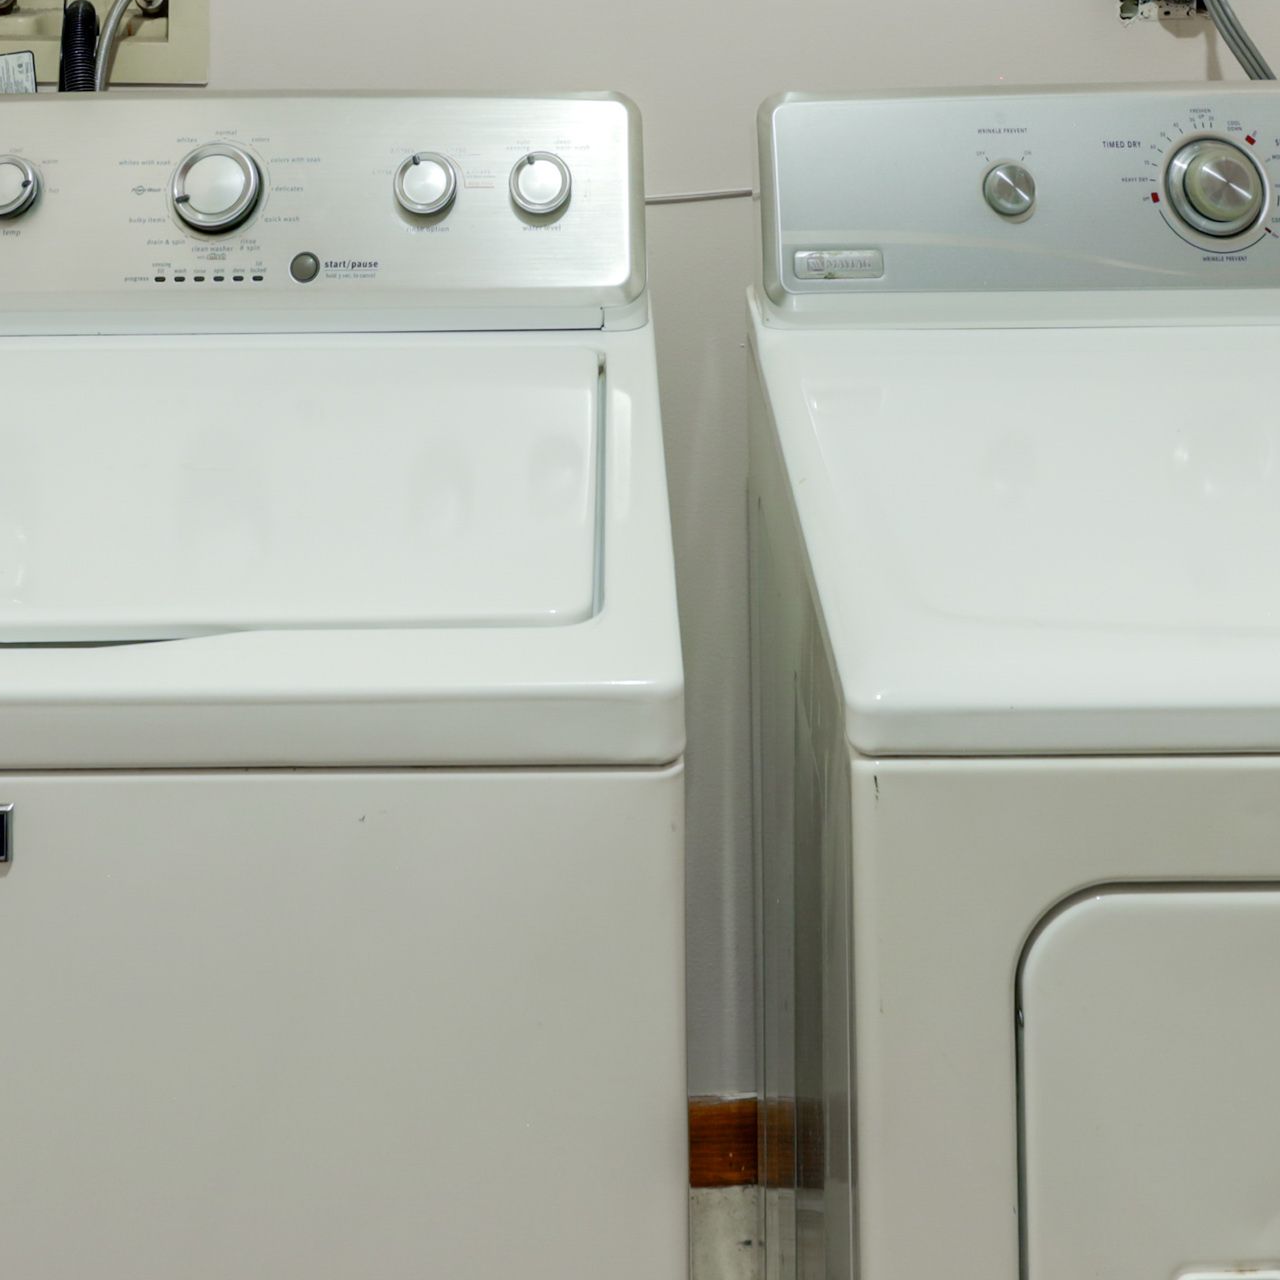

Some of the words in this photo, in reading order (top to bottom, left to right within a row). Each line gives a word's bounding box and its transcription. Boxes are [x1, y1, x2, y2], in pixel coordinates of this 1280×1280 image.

[1102, 140, 1125, 148] TIMED
[1127, 140, 1141, 148] DRY
[264, 216, 281, 224] quick
[0, 228, 21, 238] temp
[324, 260, 379, 270] start/pause
